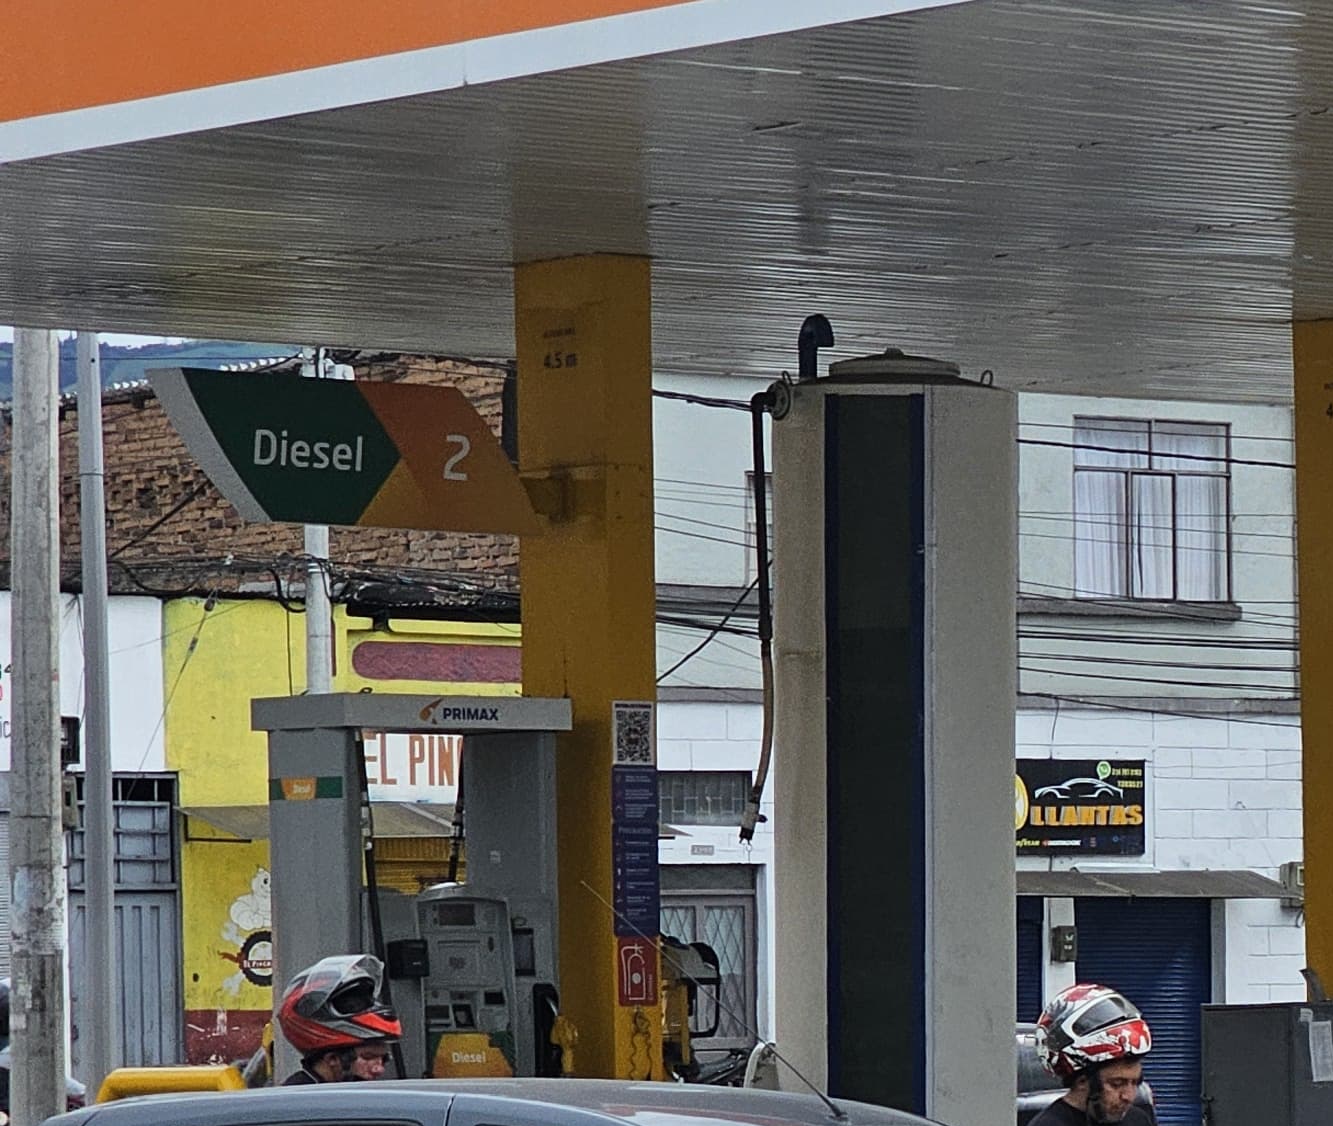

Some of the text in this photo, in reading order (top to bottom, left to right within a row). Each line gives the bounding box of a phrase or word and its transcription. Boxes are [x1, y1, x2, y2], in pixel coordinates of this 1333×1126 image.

[254, 429, 363, 472] Diesel
[443, 434, 471, 481] 2
[443, 708, 498, 721] PRIMAX
[363, 733, 465, 786] EL PIN
[452, 1051, 486, 1063] Diesel
